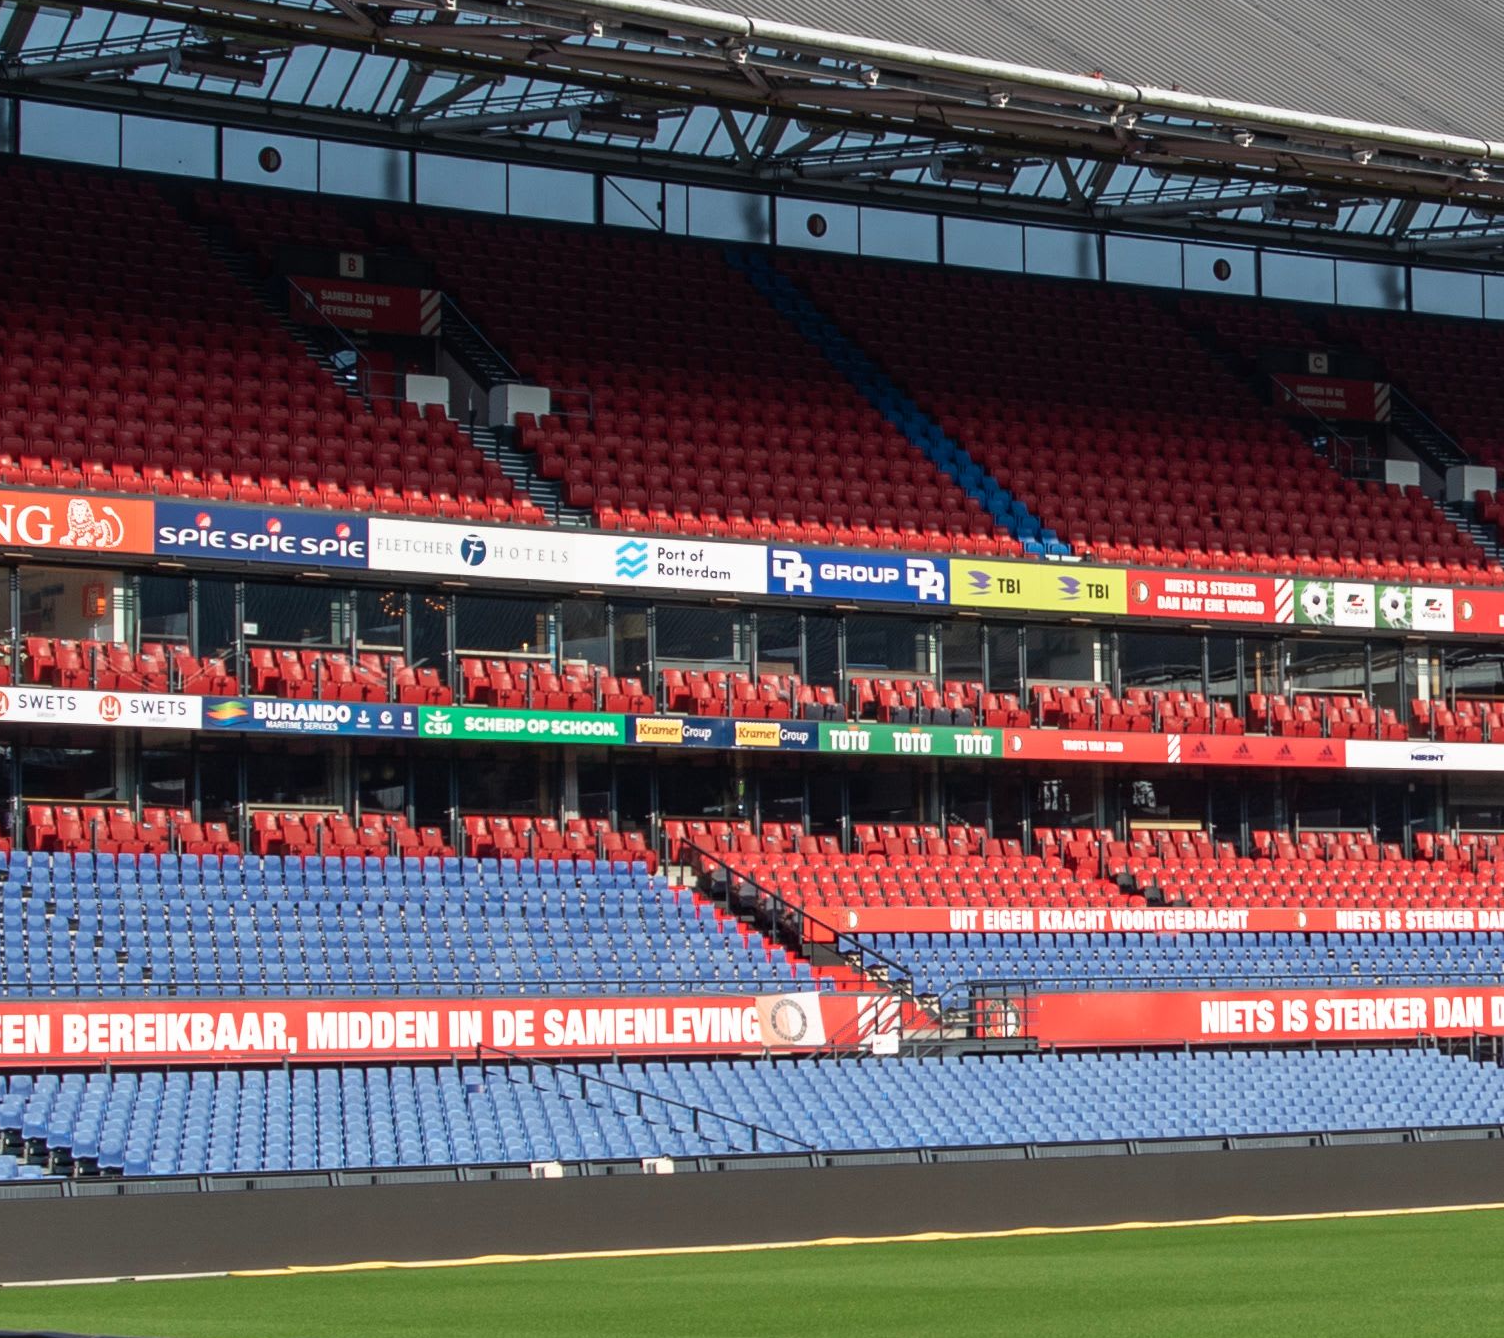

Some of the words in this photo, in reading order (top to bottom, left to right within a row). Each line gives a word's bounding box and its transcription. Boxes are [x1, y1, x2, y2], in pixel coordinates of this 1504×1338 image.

[159, 525, 226, 549] SPIE
[231, 531, 296, 554] SPIE
[301, 536, 365, 558] SPIE
[377, 538, 454, 557] FLETCHER
[493, 546, 569, 564] HOTELS
[657, 547, 686, 562] Port
[690, 550, 704, 563] of
[657, 563, 731, 581] Rotterdam
[820, 563, 899, 584] GROUP
[997, 578, 1021, 594] TBI
[1086, 583, 1109, 600] TBI
[17, 693, 77, 712] SWETS
[129, 699, 187, 716] SWETS
[253, 701, 352, 724] BURANDO
[424, 721, 453, 735] CSU
[463, 716, 526, 734] SCHERP
[526, 719, 549, 734] OP
[550, 721, 620, 737] SCHOON.
[639, 723, 679, 736] Kramer
[682, 725, 712, 741] Group
[738, 727, 777, 739] Kramer
[779, 729, 809, 744] Group
[829, 730, 871, 751] TOTO
[893, 732, 932, 753] TOTO
[954, 734, 994, 755] TOTO
[949, 909, 978, 930] UIT
[983, 909, 1034, 930] EIGEN
[1038, 909, 1105, 930] KRACHT
[1109, 909, 1249, 930] VOORTGEBRACHT
[1334, 910, 1381, 930] NIETS
[1385, 910, 1402, 930] IS
[1405, 910, 1474, 930] STERKER
[1201, 999, 1275, 1034] NIETS
[1282, 999, 1309, 1032] IS
[1314, 996, 1428, 1031] STERKER
[1433, 995, 1484, 1029] DAN
[63, 1012, 298, 1055] BEREIKBAAR,
[306, 1011, 439, 1050] MIDDEN
[448, 1010, 483, 1047] IN
[491, 1009, 535, 1047] DE
[542, 1006, 760, 1047] SAMENLEVING
